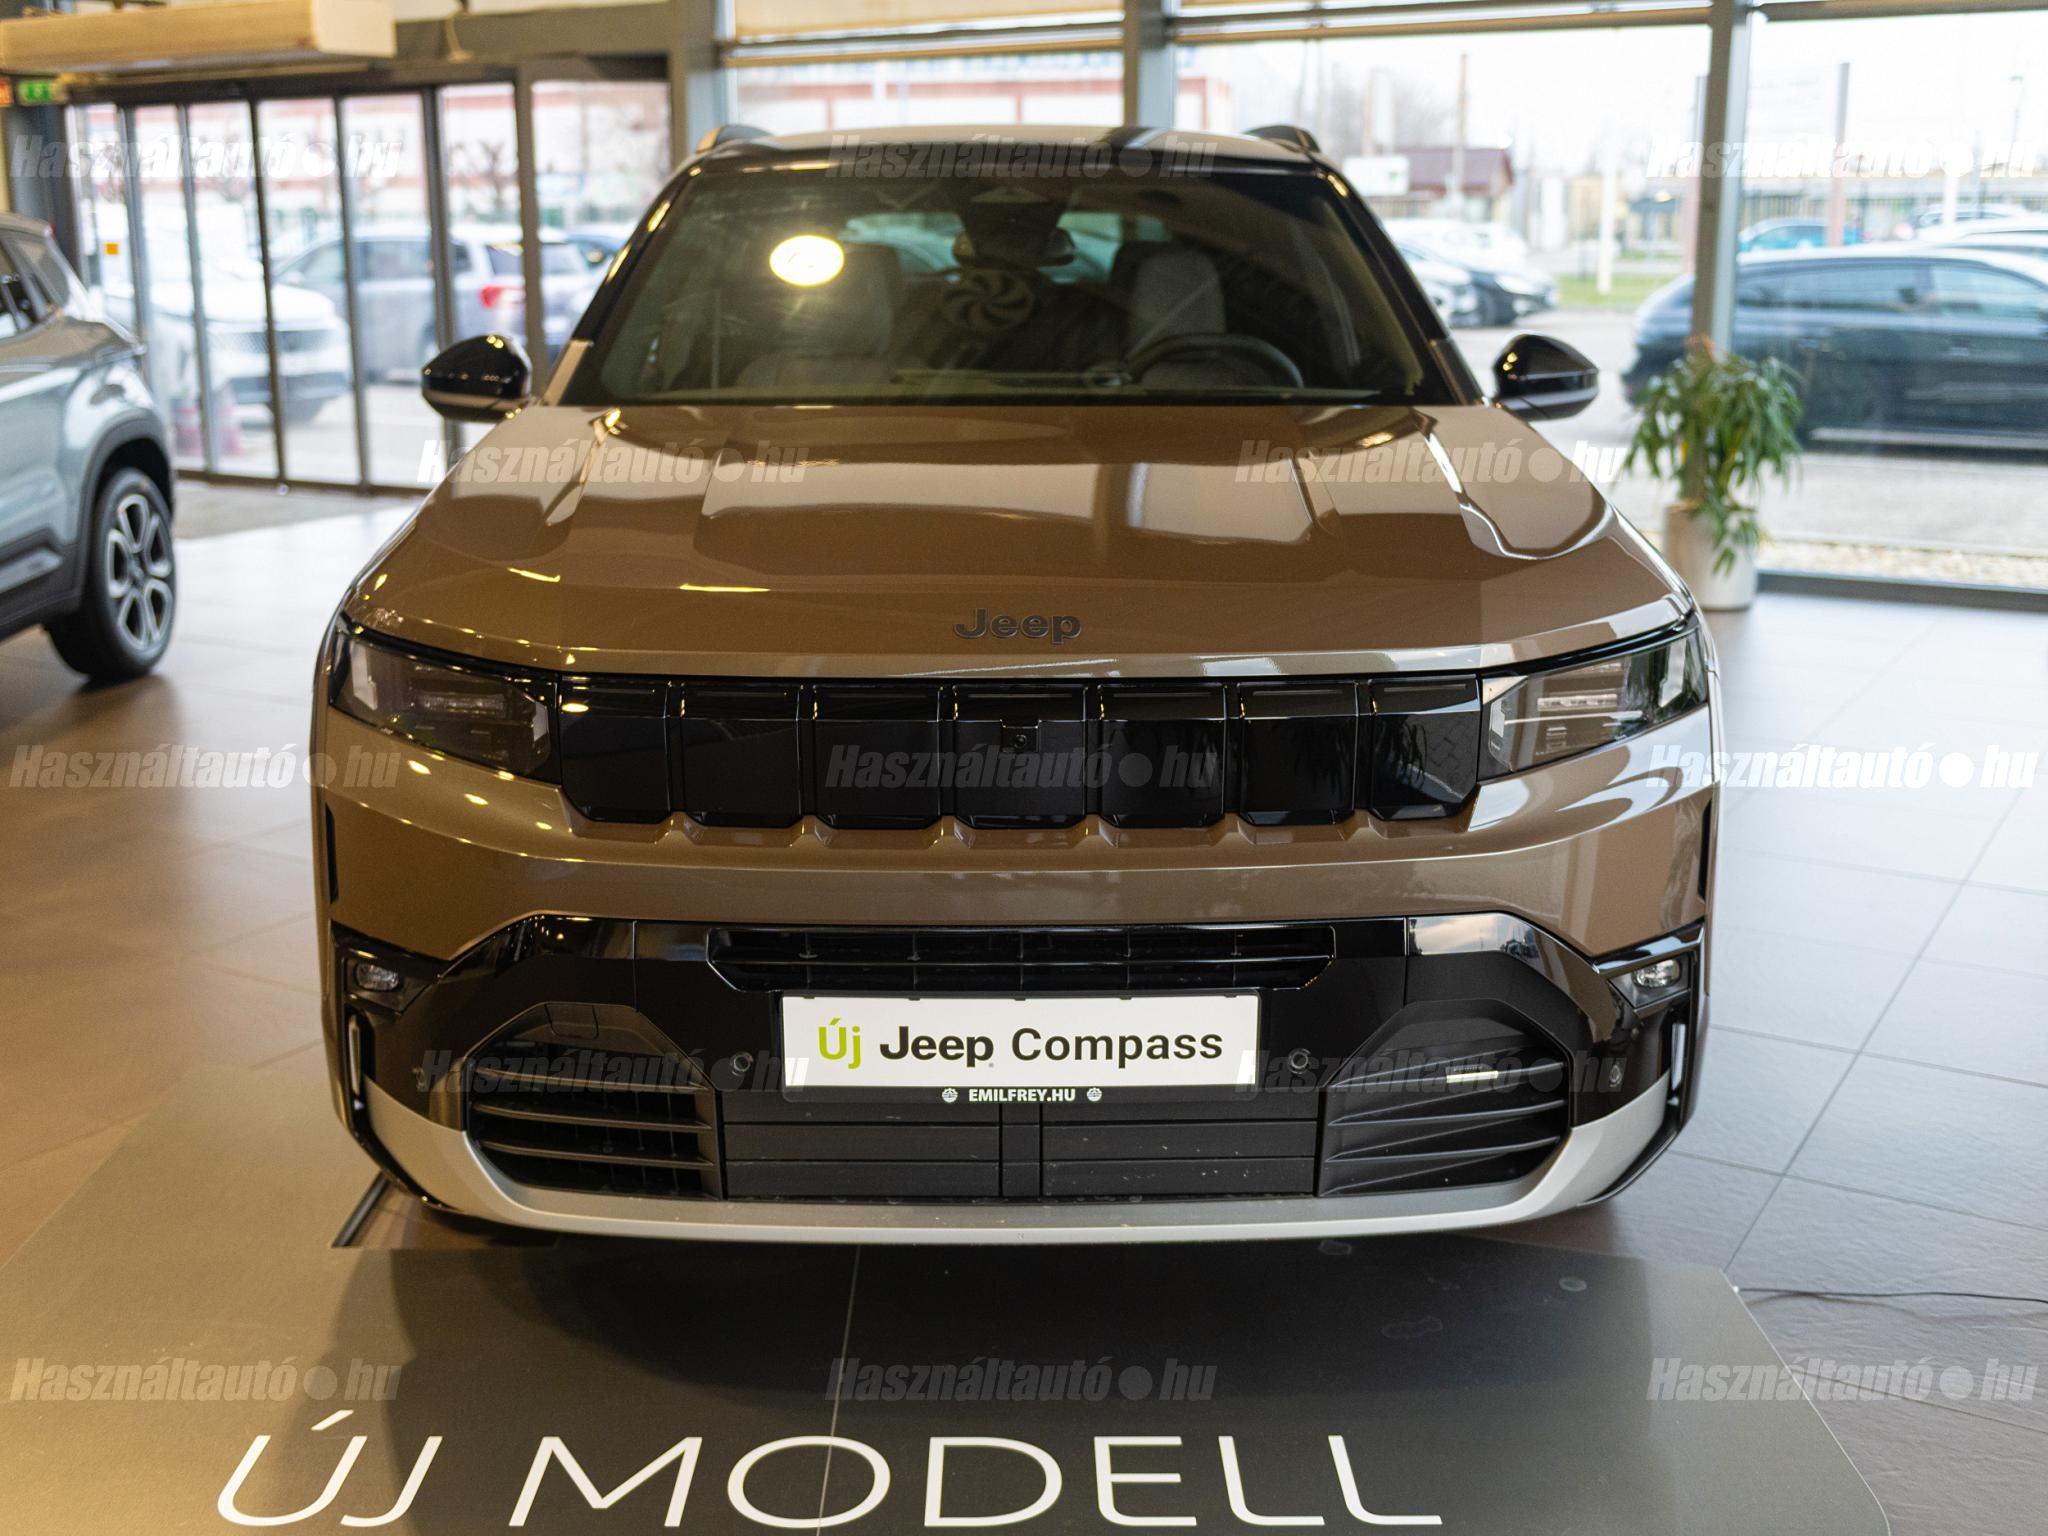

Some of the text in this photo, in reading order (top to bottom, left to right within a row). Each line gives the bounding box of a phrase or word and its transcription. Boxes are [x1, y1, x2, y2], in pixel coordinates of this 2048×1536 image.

[953, 607, 1082, 645] Jeep
[818, 1017, 1224, 1069] Új Jeep Compass
[968, 1087, 1076, 1102] EMILFREY.HU
[216, 1409, 1443, 1529] ÚJ MODELL
